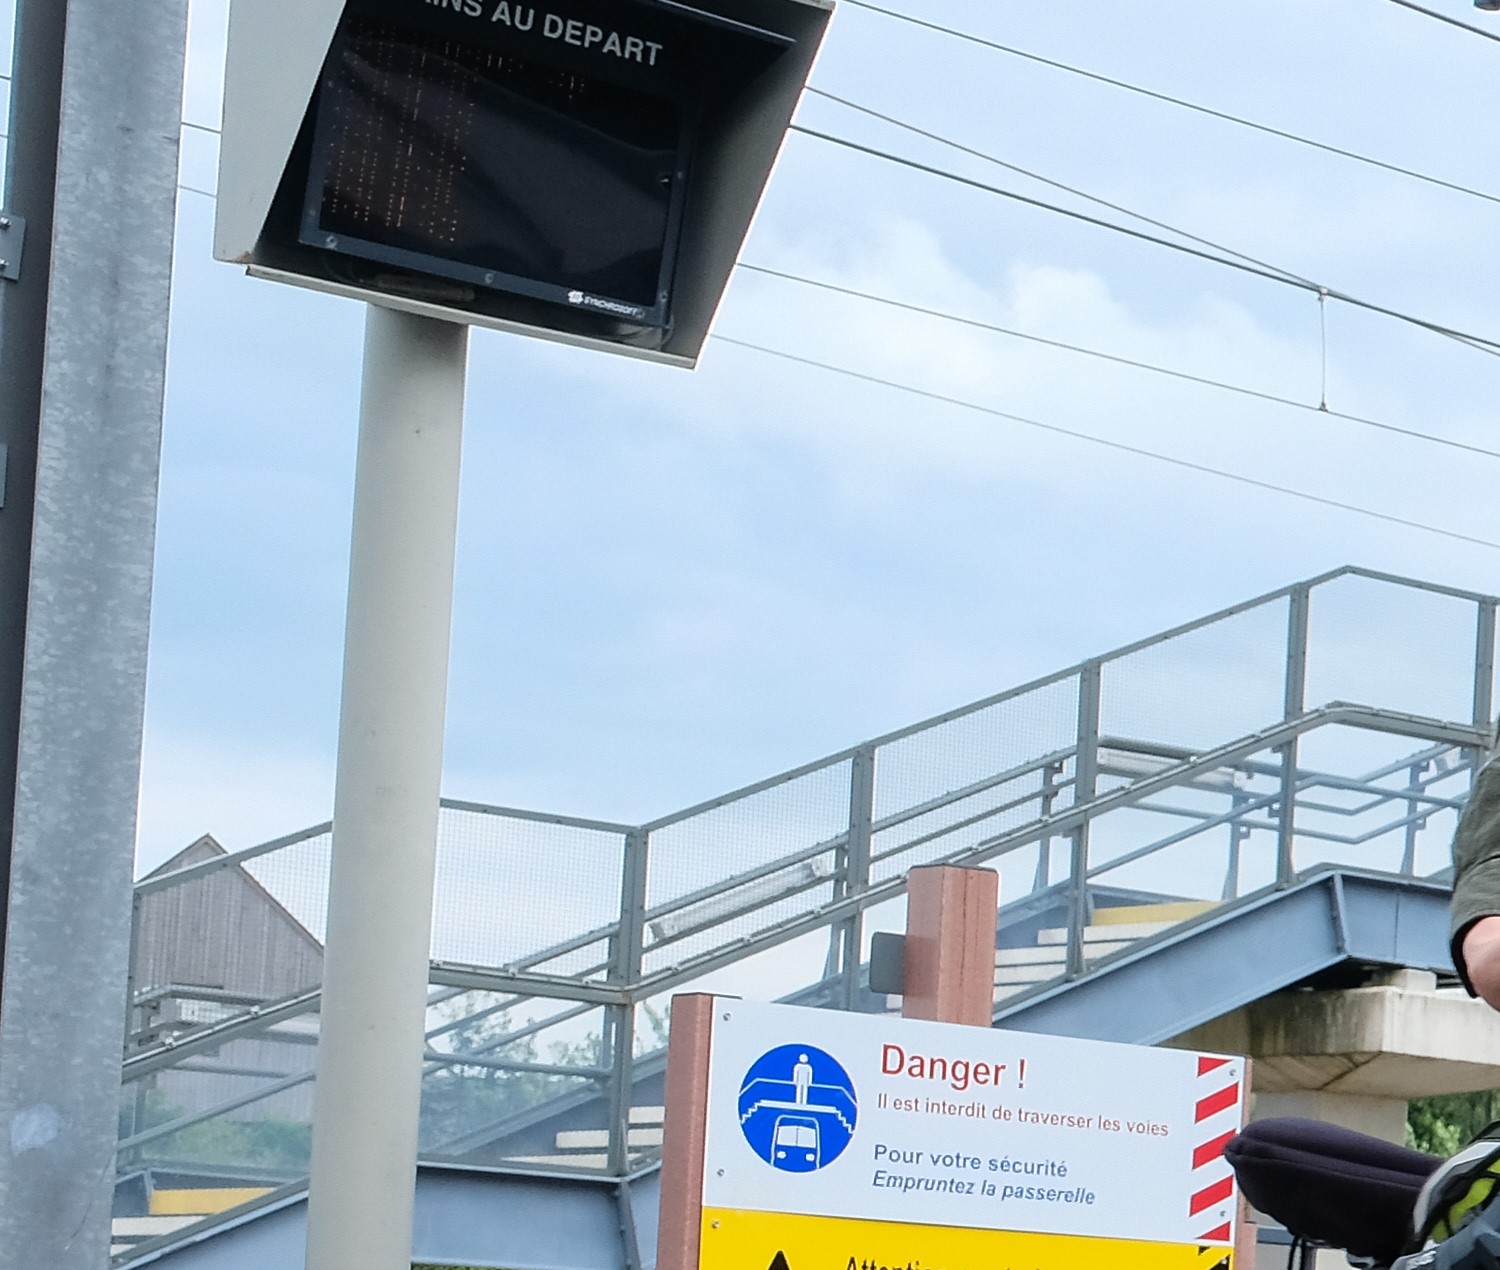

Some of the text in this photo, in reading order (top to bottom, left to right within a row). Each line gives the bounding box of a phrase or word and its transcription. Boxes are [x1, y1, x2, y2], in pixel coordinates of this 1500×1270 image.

[492, 1, 534, 31] AU
[543, 14, 663, 67] DEPART
[881, 1044, 1006, 1090] Danger
[892, 1097, 919, 1112] est
[924, 1097, 985, 1118] interdit
[991, 1104, 1012, 1121] de
[1017, 1107, 1093, 1128] traverser
[1097, 1114, 1120, 1131] les
[1126, 1120, 1168, 1136] voies
[873, 1143, 1067, 1177] Pour votre sécurité
[871, 1169, 1095, 1204] Empruntez la passerelle
